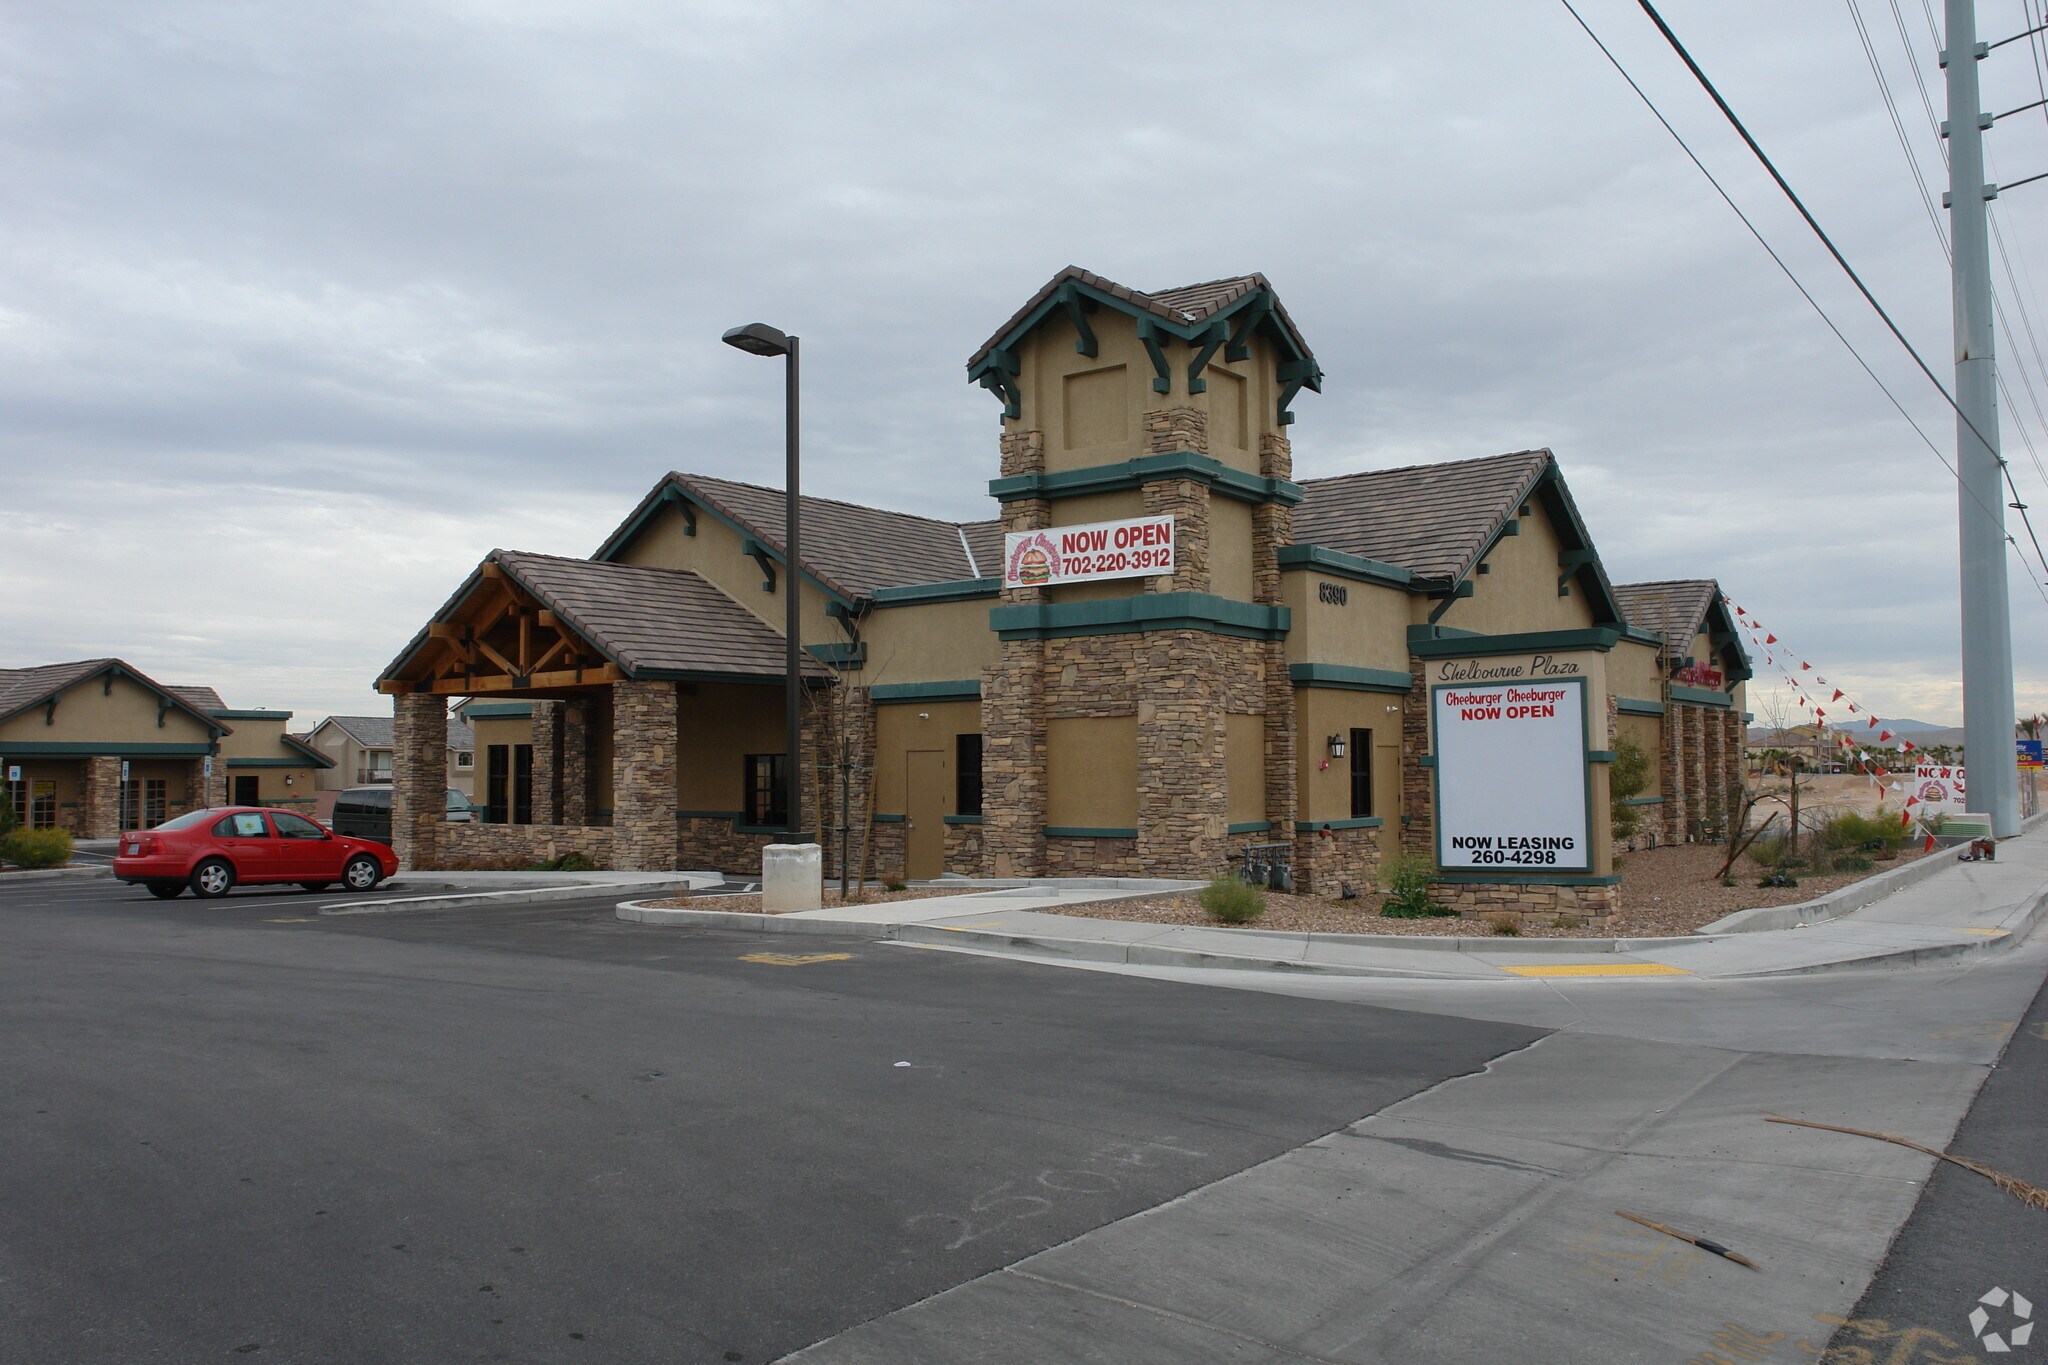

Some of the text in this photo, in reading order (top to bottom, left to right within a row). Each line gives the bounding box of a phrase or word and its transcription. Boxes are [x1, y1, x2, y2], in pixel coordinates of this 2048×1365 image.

[1062, 523, 1170, 554] NOW OPEN
[1062, 548, 1170, 575] 702-220-3912
[1438, 655, 1579, 681] Shelbourne Plaza
[1445, 688, 1566, 706] Cheeburger Cheeburger
[1461, 705, 1554, 721] NOW OPEN
[1452, 837, 1574, 849] NOW LEASING
[1471, 850, 1556, 864] 260-4298
